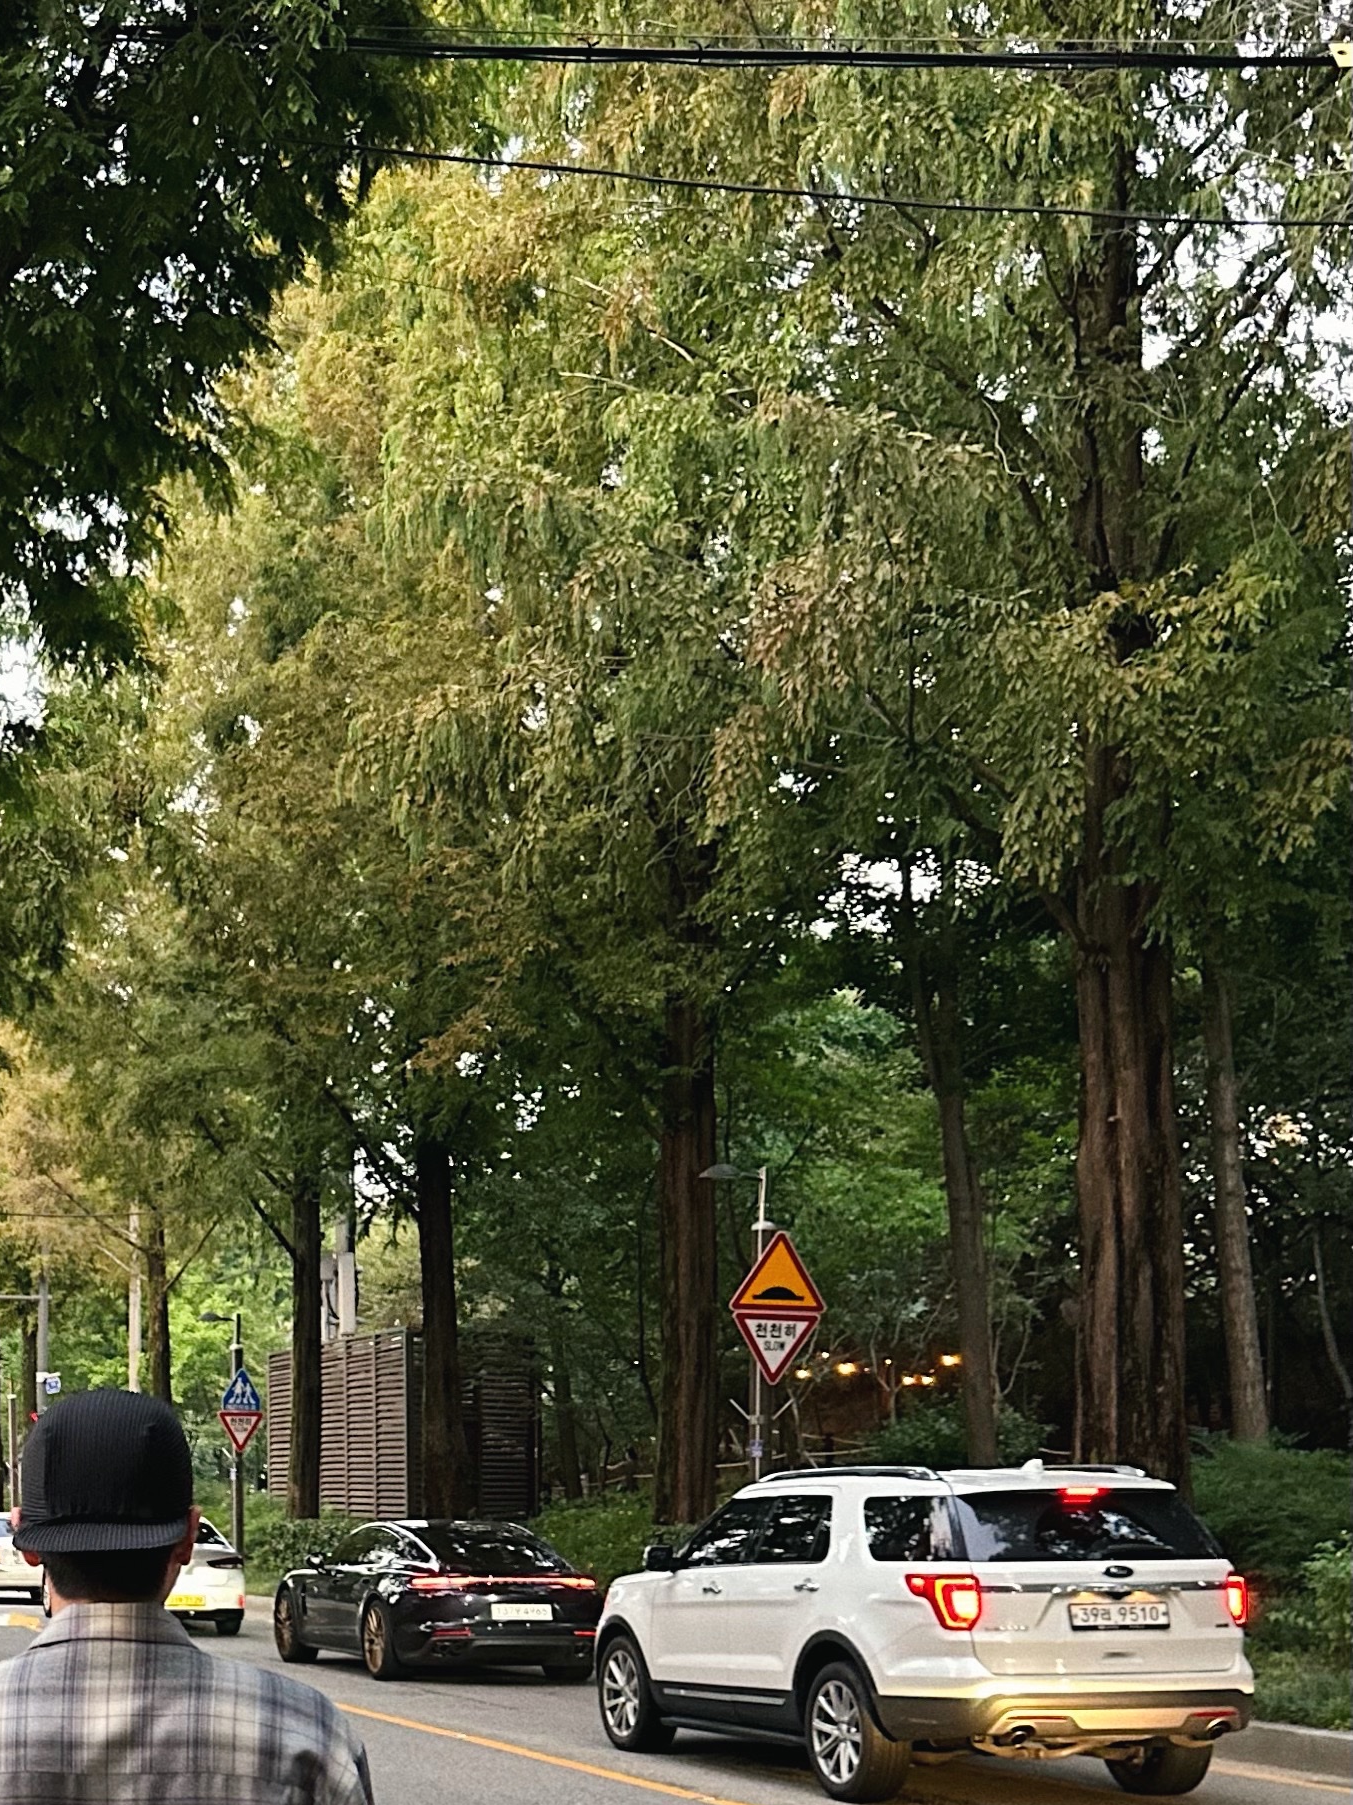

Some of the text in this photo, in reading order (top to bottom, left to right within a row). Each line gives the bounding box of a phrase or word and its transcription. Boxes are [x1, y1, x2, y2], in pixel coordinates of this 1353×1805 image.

[755, 1322, 797, 1339] 천천히
[763, 1341, 785, 1351] SLOW
[1118, 1606, 1159, 1622] 9510
